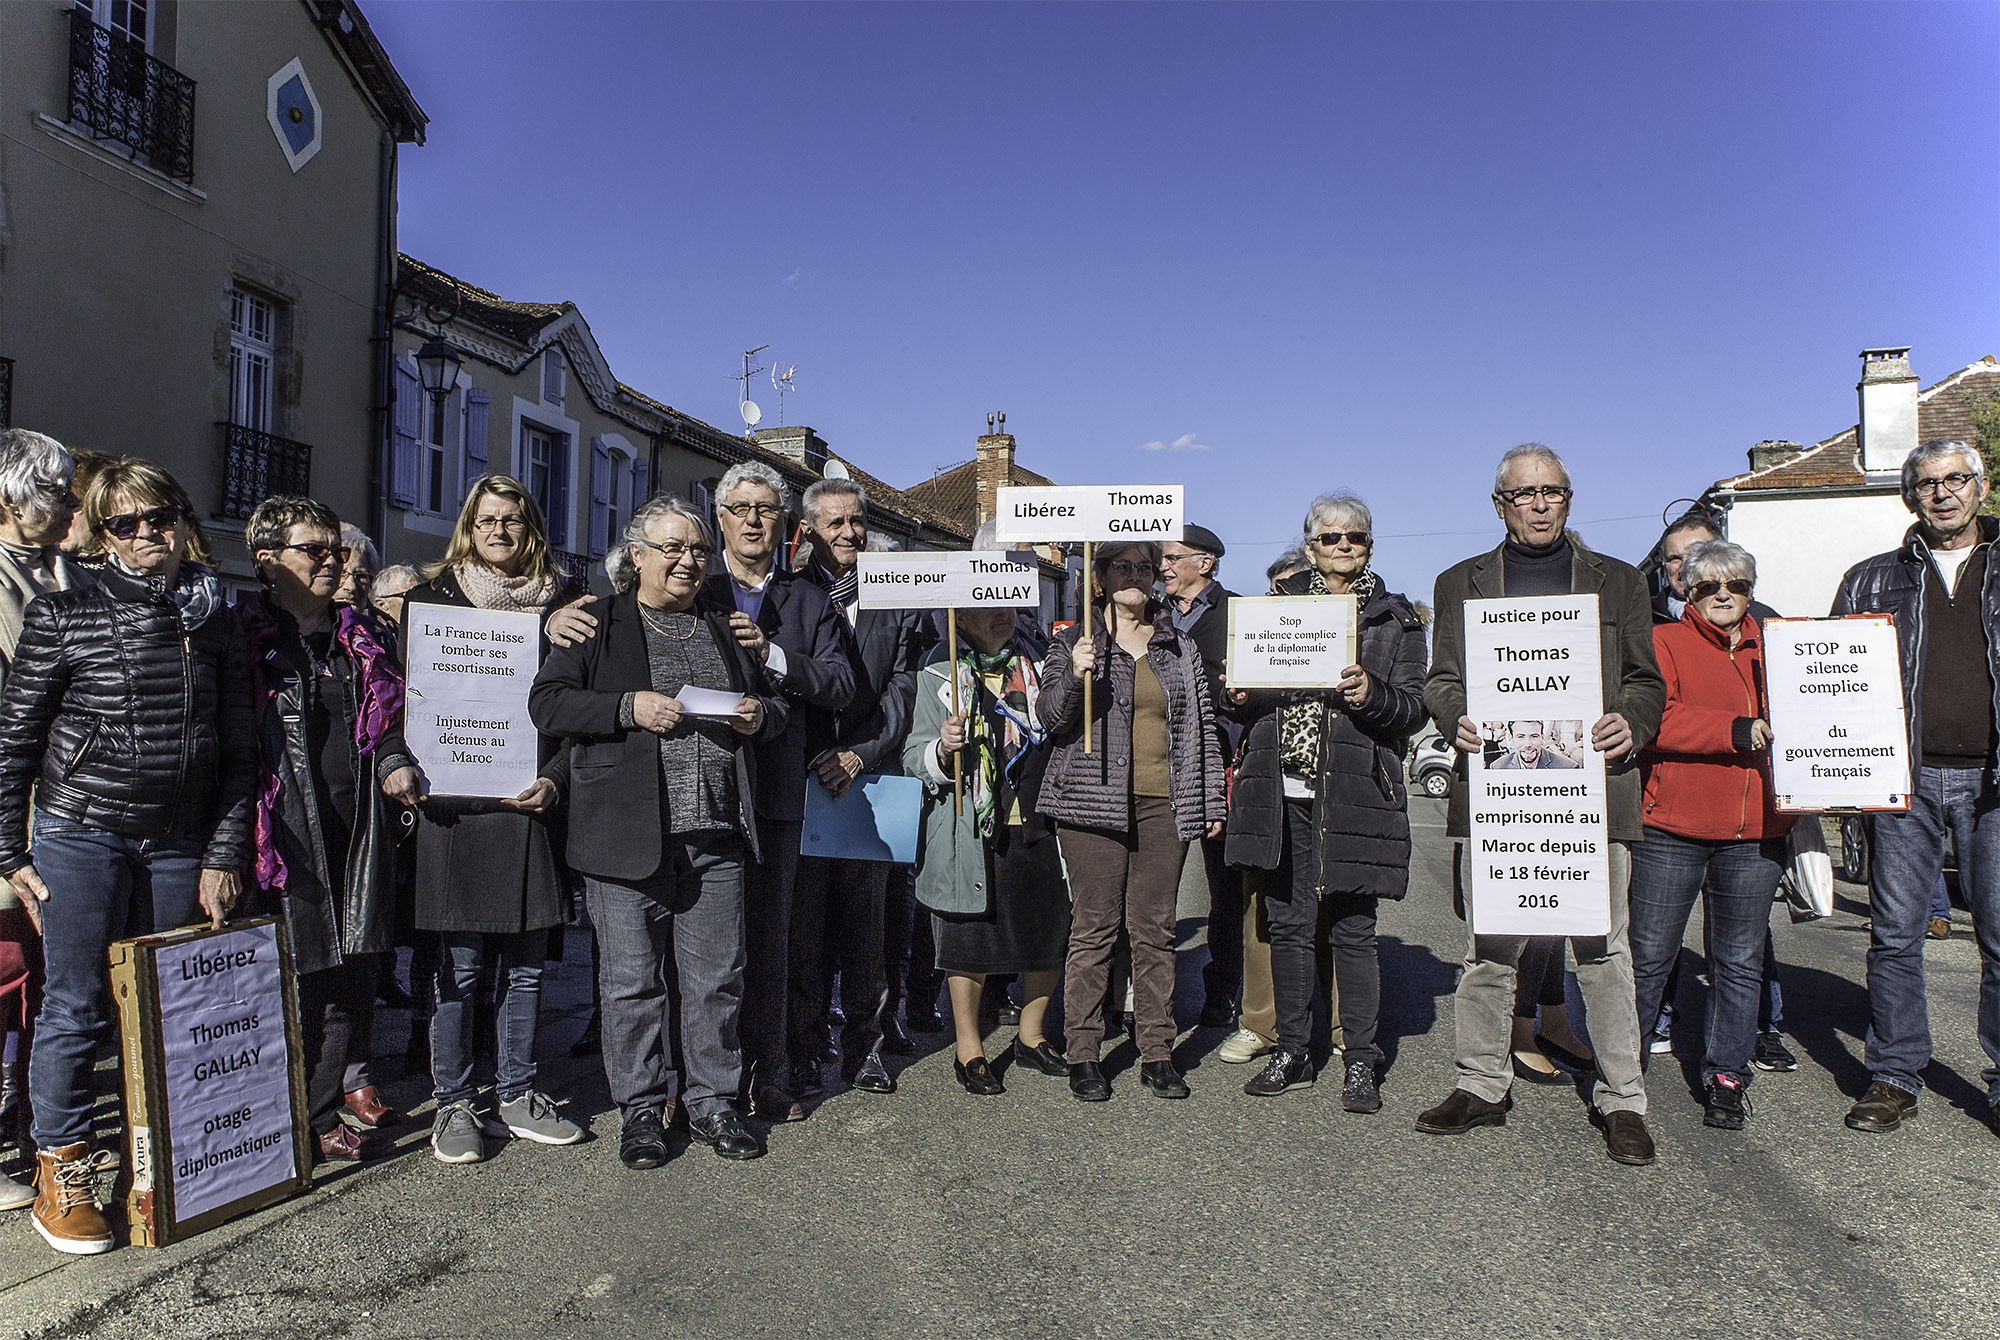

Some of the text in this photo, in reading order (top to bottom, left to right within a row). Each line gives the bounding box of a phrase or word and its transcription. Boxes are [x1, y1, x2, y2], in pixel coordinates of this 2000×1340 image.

[1107, 491, 1173, 506] Thomas
[1014, 502, 1076, 518] Libérez
[1108, 518, 1173, 533] GALLAY
[969, 558, 1031, 574] Thomas
[862, 570, 947, 587] Justice pour
[971, 585, 1032, 601] GALLAY
[1279, 615, 1302, 629] Stop
[1480, 608, 1581, 625] Justice pour
[424, 623, 525, 644] La France laisse
[1244, 629, 1337, 642] au silence complice
[441, 644, 508, 660] tomber ses
[1253, 642, 1327, 655] de la diplomatie
[1493, 645, 1570, 663] Thomas
[1793, 642, 1868, 657] STOP au
[432, 661, 515, 677] ressortissants
[1269, 655, 1311, 668] française
[1805, 661, 1859, 675] silence
[1496, 675, 1571, 693] GALLAY
[1799, 679, 1869, 697] complice
[433, 714, 511, 731] Injustement
[438, 732, 506, 748] détenus au
[1828, 724, 1848, 739] du
[450, 750, 493, 764] Maroc
[1785, 745, 1896, 762] gouvernement
[1810, 763, 1872, 781] français
[1486, 782, 1588, 800] injustement
[1475, 809, 1600, 827] emprisonné au
[1482, 838, 1597, 857] Maroc depuis
[1489, 864, 1591, 881] le 18 février
[1517, 894, 1559, 909] 2016
[180, 946, 258, 981] Libérez
[189, 1014, 261, 1046] Thomas
[194, 1047, 262, 1083] GALLAY
[203, 1107, 252, 1135] otage
[135, 1136, 147, 1177] Azura
[178, 1129, 282, 1178] diplomatique
